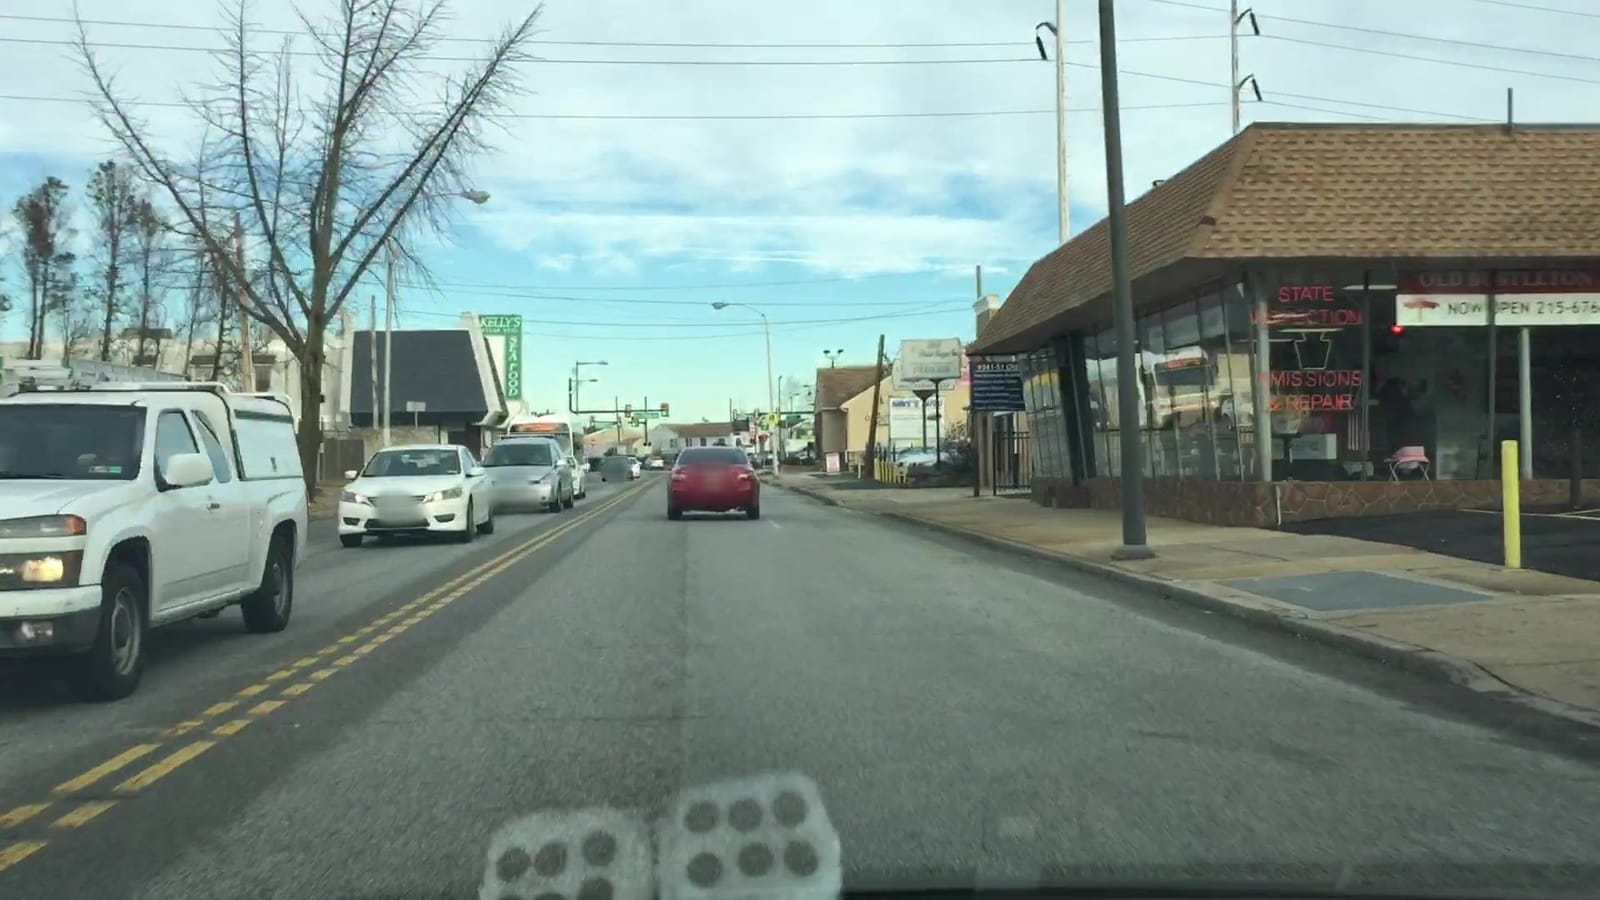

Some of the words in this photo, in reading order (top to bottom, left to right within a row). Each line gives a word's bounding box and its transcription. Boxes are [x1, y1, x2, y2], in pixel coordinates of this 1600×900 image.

[1278, 286, 1334, 303] STATE
[1447, 302, 1481, 315] NOW
[1286, 394, 1353, 411] REPAIR
